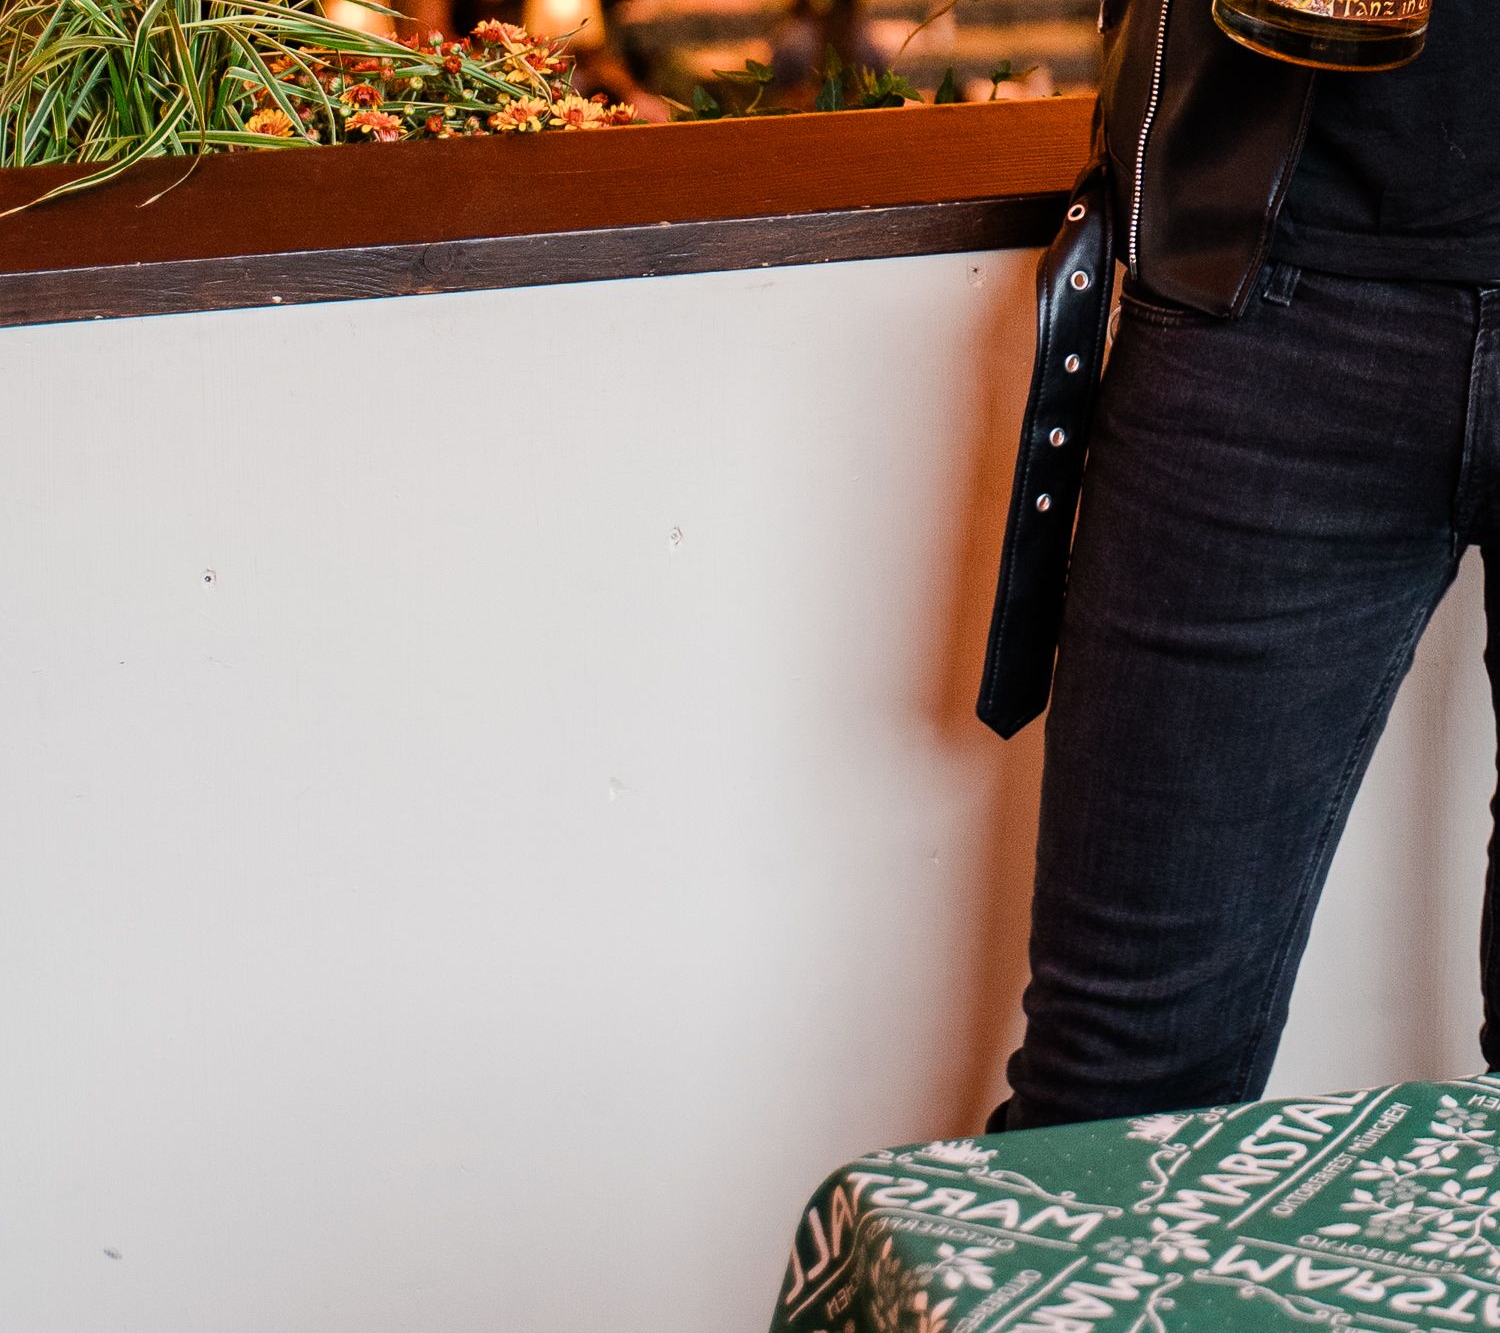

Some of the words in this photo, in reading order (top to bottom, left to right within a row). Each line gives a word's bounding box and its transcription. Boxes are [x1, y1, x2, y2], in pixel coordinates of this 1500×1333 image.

[1156, 1091, 1369, 1224] MARSTAL
[1272, 1152, 1357, 1218] OKTOBERFEST
[1350, 1102, 1412, 1153] MÜNCHEN
